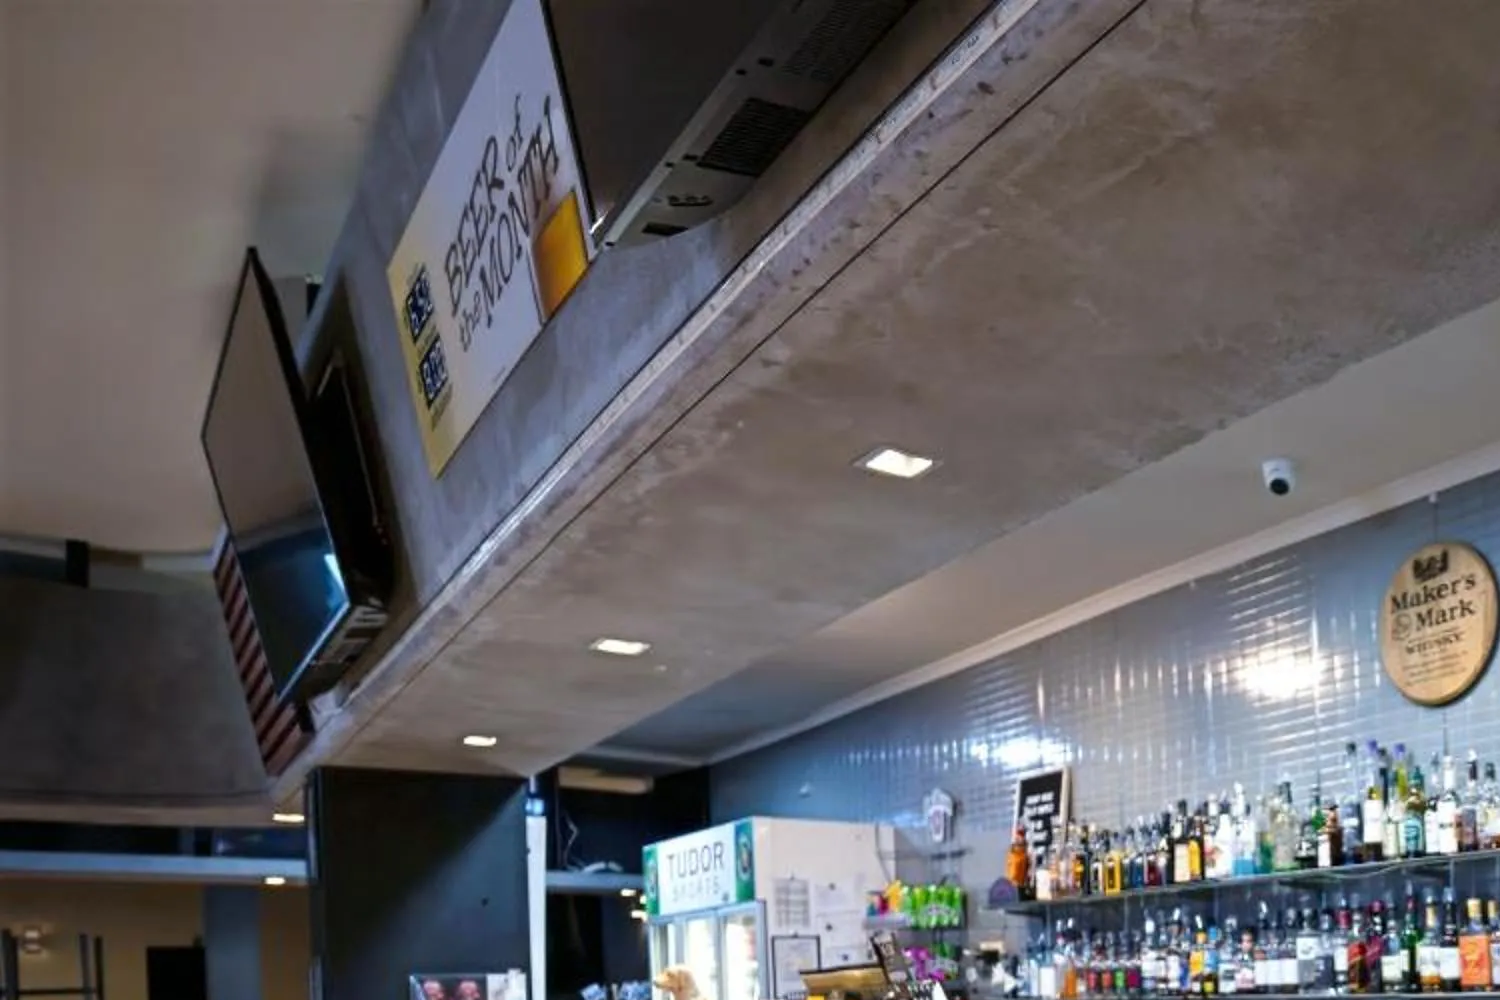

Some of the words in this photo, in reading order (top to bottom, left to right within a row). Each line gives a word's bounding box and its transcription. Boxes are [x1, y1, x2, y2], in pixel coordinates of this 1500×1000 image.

[445, 135, 504, 318] BEER
[480, 95, 560, 330] MONTH
[1391, 574, 1476, 614] Maker's
[1416, 599, 1475, 632] Mark
[666, 841, 724, 880] TUDOR
